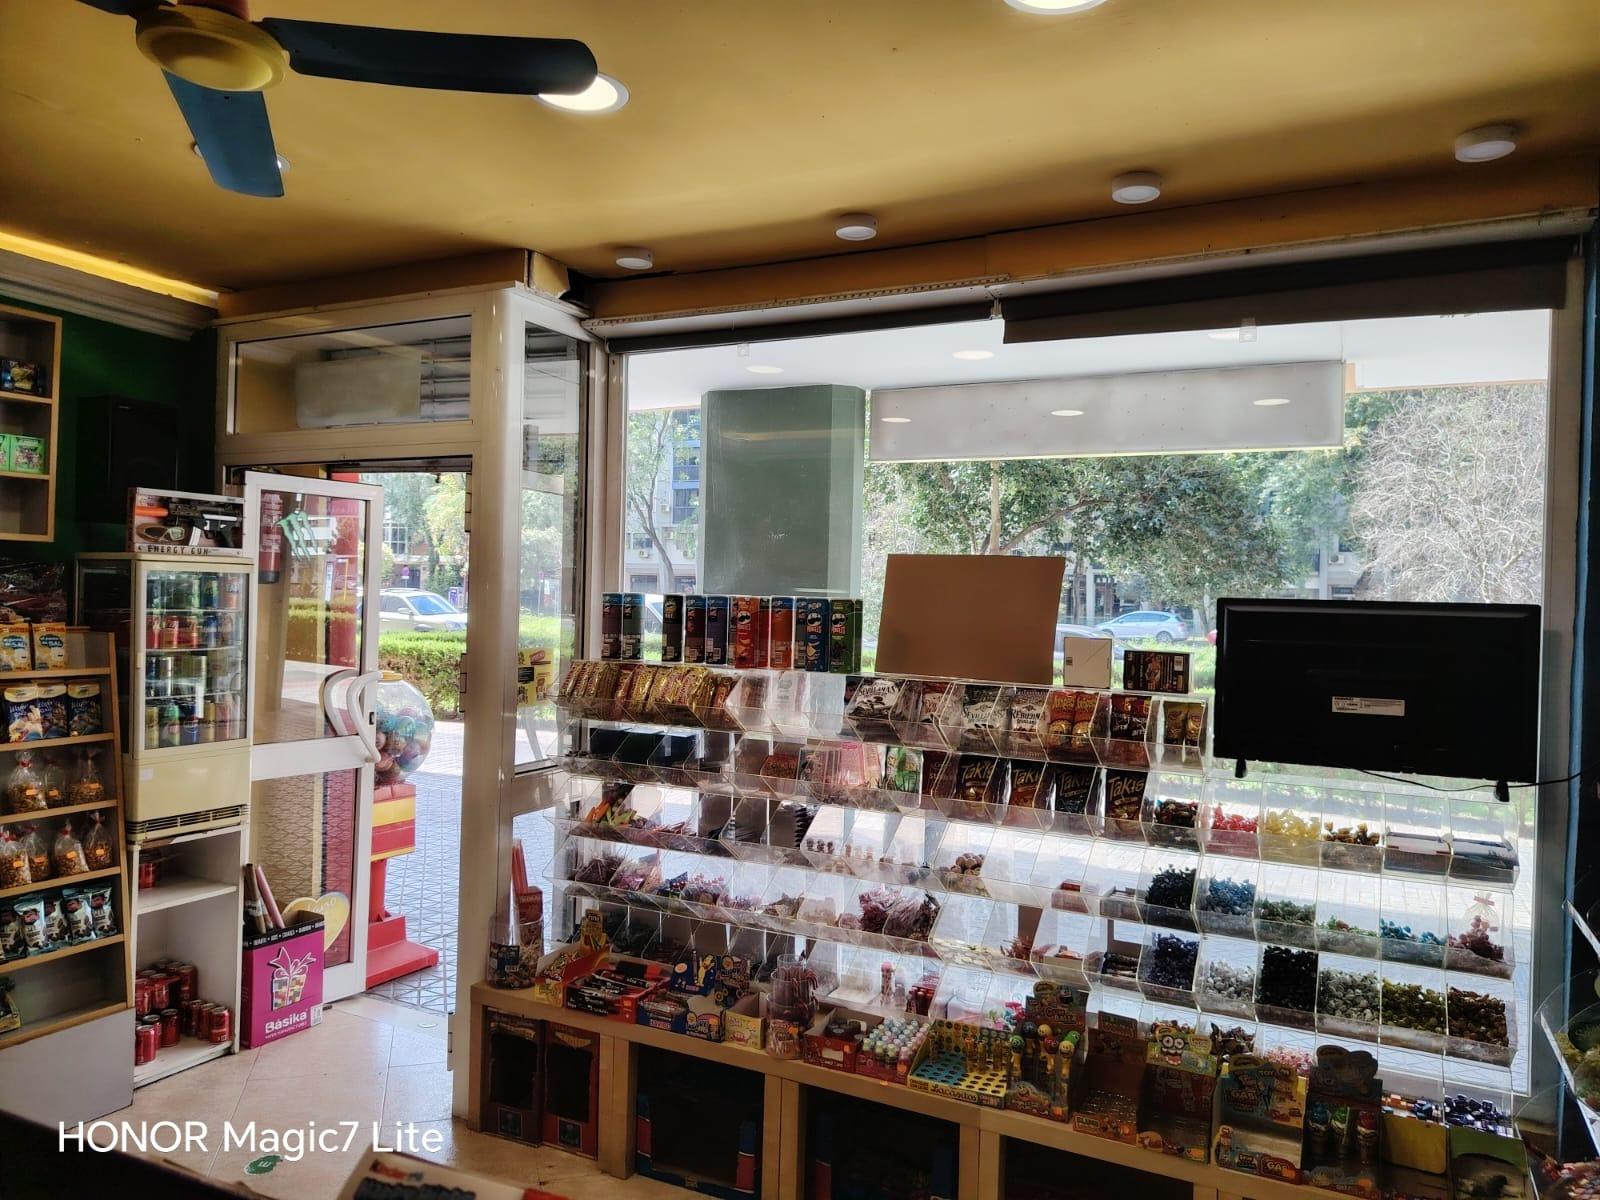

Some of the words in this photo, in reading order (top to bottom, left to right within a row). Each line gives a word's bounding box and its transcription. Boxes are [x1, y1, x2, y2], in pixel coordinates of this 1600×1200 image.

[147, 545, 185, 554] ENERGY
[191, 547, 209, 555] GUN
[1107, 776, 1145, 800] Takis
[931, 1084, 977, 1101] Lacasitos
